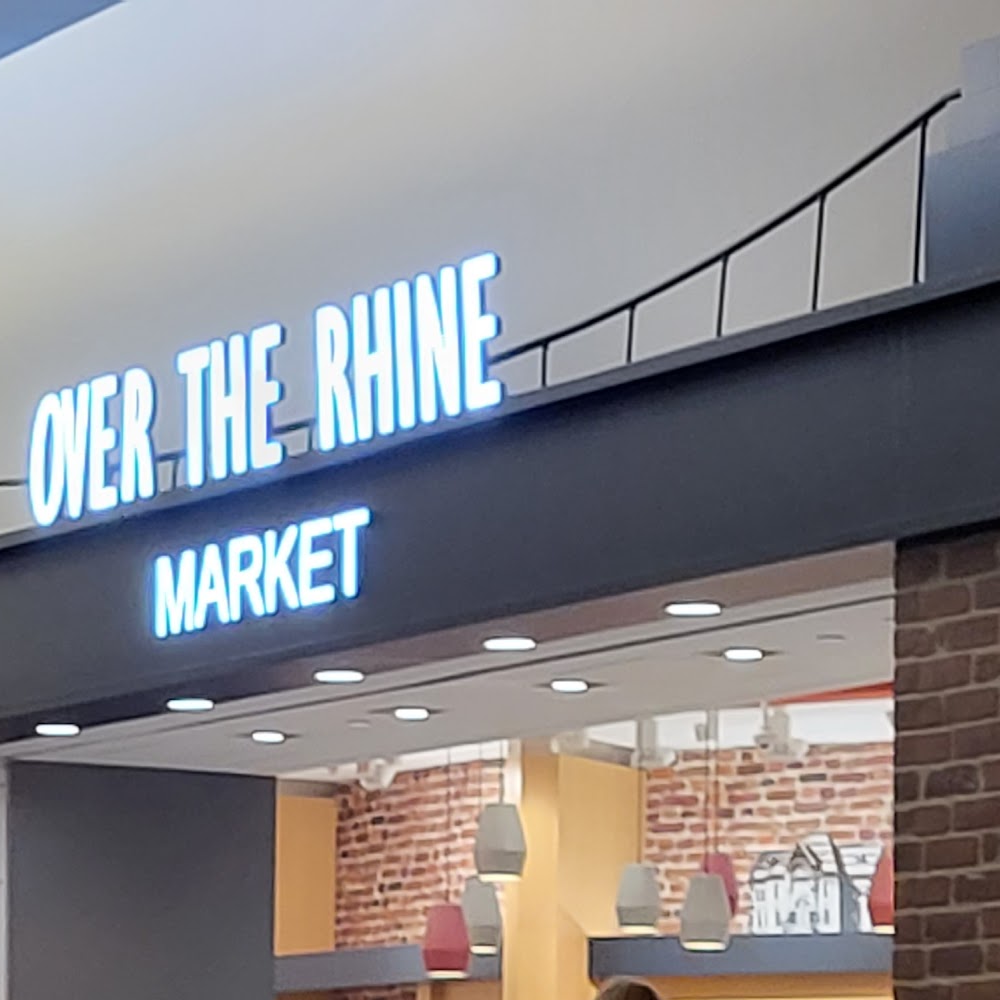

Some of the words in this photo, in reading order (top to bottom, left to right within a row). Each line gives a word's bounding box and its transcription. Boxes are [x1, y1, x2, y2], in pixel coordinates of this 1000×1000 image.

[28, 367, 155, 527] OVER
[177, 323, 284, 487] THE
[315, 252, 503, 452] RHINE
[153, 506, 372, 639] MARKET
